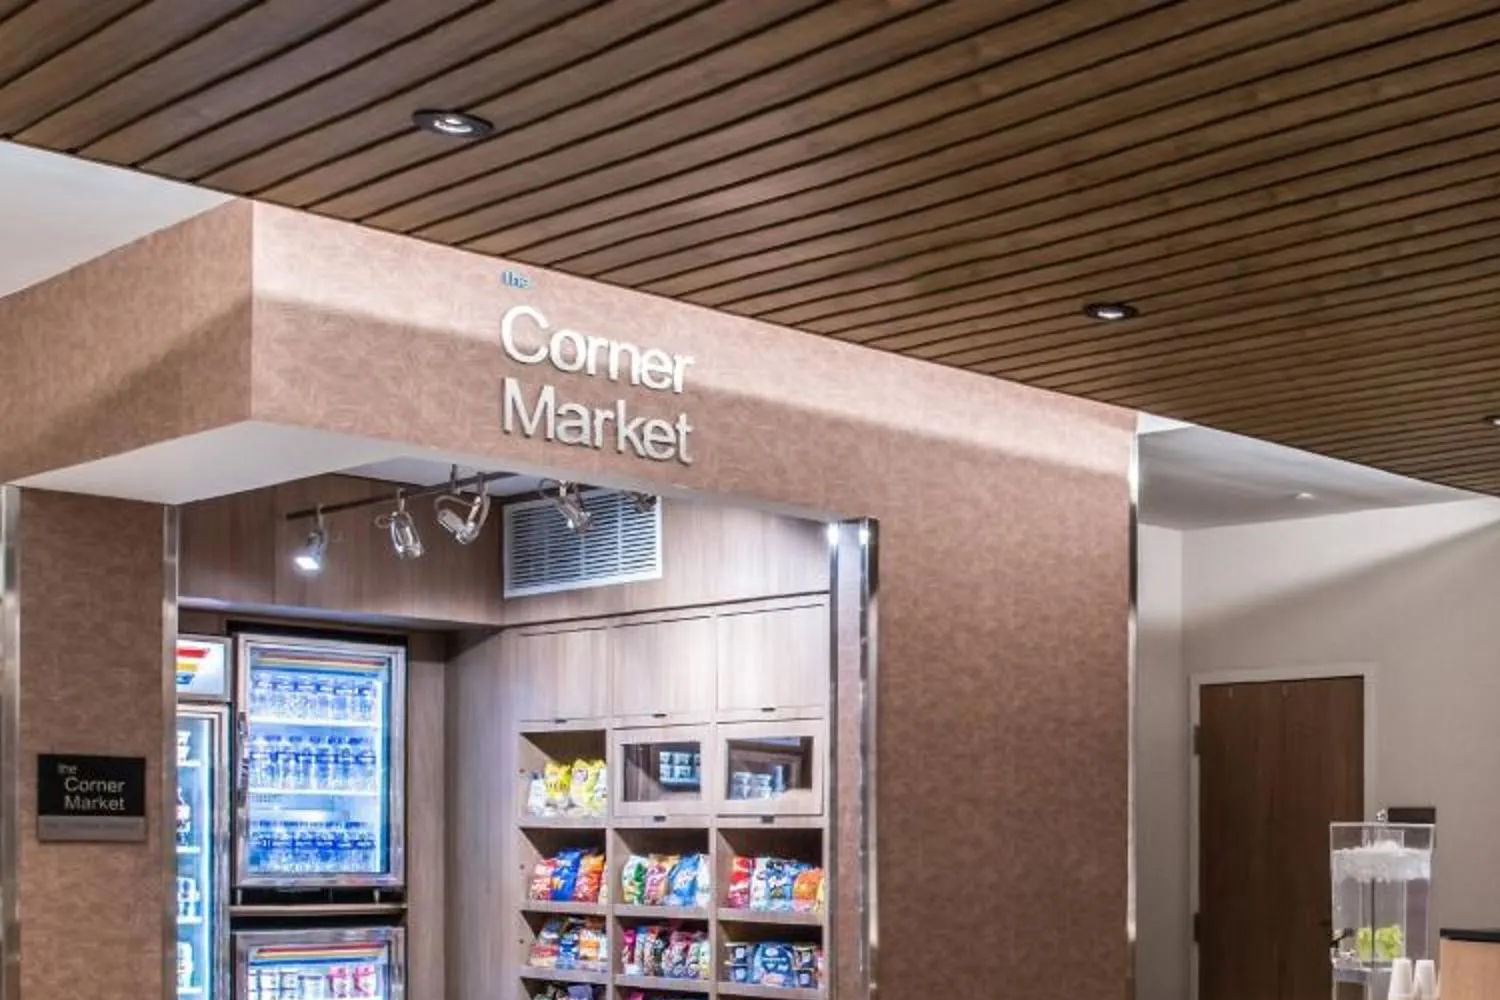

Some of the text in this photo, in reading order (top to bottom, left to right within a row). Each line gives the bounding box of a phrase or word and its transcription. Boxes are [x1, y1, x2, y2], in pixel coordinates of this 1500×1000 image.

[501, 305, 695, 393] Corner
[502, 377, 694, 465] Market
[64, 776, 126, 793] Corner
[64, 795, 126, 811] Market
